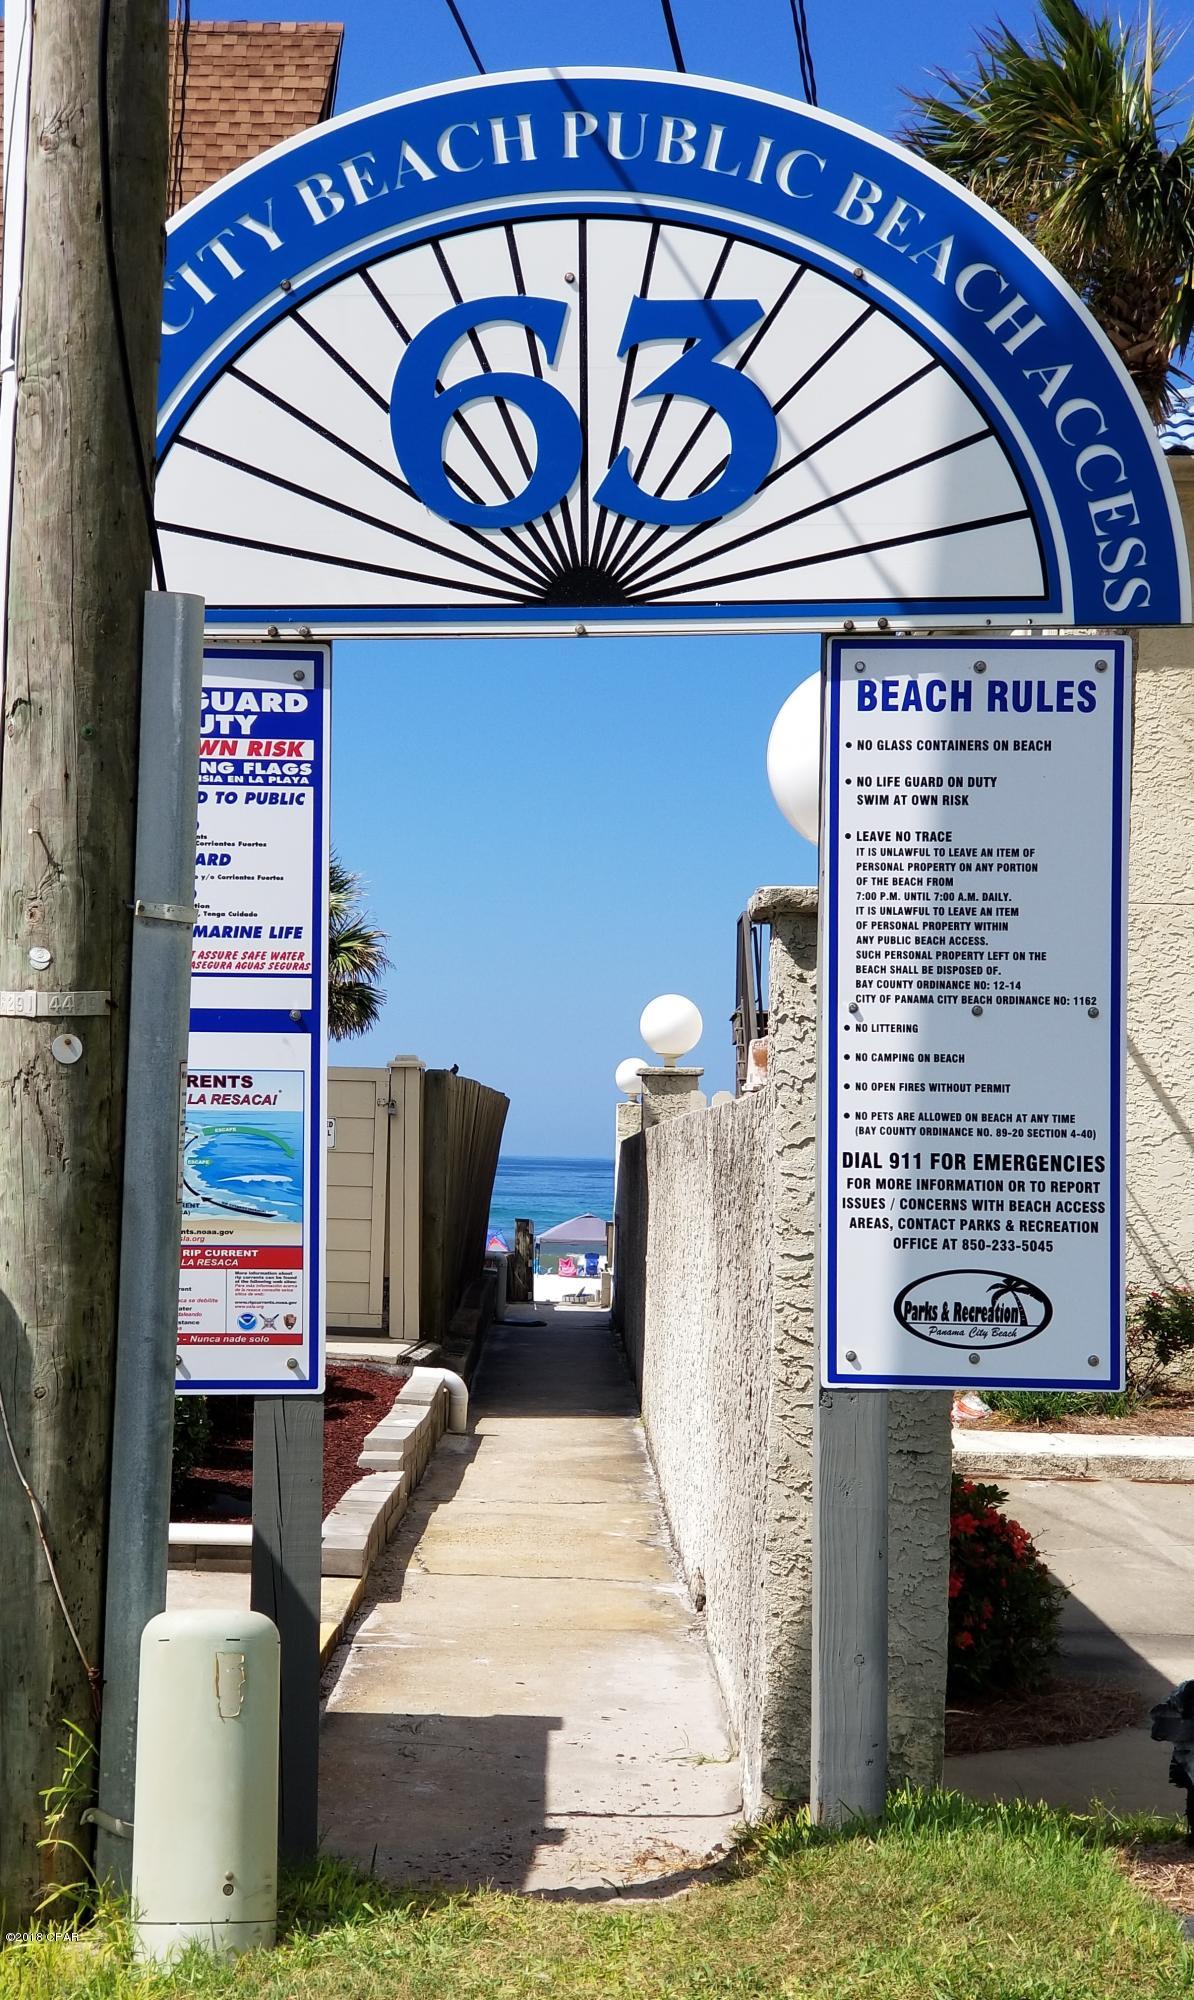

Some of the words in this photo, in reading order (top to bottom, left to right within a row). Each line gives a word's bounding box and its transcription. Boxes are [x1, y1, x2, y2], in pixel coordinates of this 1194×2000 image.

[294, 113, 538, 226] BEACH
[562, 110, 827, 199] PUBLIC
[832, 171, 1048, 357] BEACH
[1021, 362, 1151, 613] ACCESS
[390, 295, 778, 527] 63
[858, 679, 972, 712] BEACH
[988, 680, 1096, 713] RULES
[246, 740, 305, 758] RISK
[856, 739, 873, 751] NO
[876, 739, 913, 751] GLASS
[916, 739, 990, 752] CONTAINERS
[992, 739, 1009, 752] ON
[1013, 739, 1052, 752] BEACH
[243, 762, 312, 775] FLAGS
[227, 775, 244, 784] EN
[248, 775, 264, 784] LA
[268, 775, 310, 785] PLAYA
[856, 775, 873, 788] NO
[876, 776, 901, 788] LIFE
[904, 776, 944, 788] GUARD
[947, 776, 964, 788] ON
[967, 776, 998, 788] DUTY
[215, 791, 238, 805] TO
[244, 791, 306, 806] PUBLIC
[856, 794, 890, 806] SWIM
[893, 794, 908, 806] AT
[911, 794, 938, 806] OWN
[942, 794, 969, 807] RISK
[856, 830, 892, 842] LEAVE
[895, 830, 912, 842] NO
[914, 830, 953, 843] TRACE
[217, 873, 255, 881] Corrientes
[257, 874, 284, 882] Fuertes
[855, 891, 877, 901] 7:00
[879, 891, 901, 901] P.M.
[903, 891, 932, 902] UNTIL
[933, 891, 955, 902] 7:00
[957, 891, 980, 902] A.M.
[981, 892, 1012, 902] DAILY.
[203, 910, 226, 919] Tenga
[228, 910, 258, 918] Cuidado
[193, 924, 263, 939] MARINE
[268, 925, 304, 940] LIFE
[855, 935, 875, 945] ANY
[877, 935, 912, 946] PUBLIC
[914, 935, 946, 946] BEACH
[948, 935, 989, 946] ACCESS.
[197, 950, 239, 960] ASSURE
[240, 950, 268, 961] SAFE
[270, 951, 306, 962] WATER
[855, 949, 882, 960] SUCH
[884, 950, 934, 960] PERSONAL
[935, 950, 985, 961] PROPERTY
[987, 951, 1010, 961] LEFT
[1012, 951, 1026, 961] ON
[1028, 951, 1047, 961] THE
[191, 960, 233, 970] ASEGURA
[235, 961, 266, 971] AGUAS
[267, 961, 311, 972] SEGURAS
[855, 964, 887, 975] BEACH
[889, 964, 919, 975] SHALL
[921, 965, 934, 975] BE
[936, 965, 984, 976] DISPOSED
[985, 965, 1002, 976] OF.
[855, 979, 874, 989] BAY
[876, 979, 914, 990] COUNTY
[916, 979, 971, 990] ORDINANCE
[973, 980, 990, 991] NO:
[992, 980, 1022, 991] 12-14
[855, 993, 877, 1004] CITY
[879, 994, 892, 1004] OF
[894, 994, 935, 1005] PANAMA
[936, 994, 959, 1005] CITY
[960, 995, 993, 1006] BEACH
[995, 995, 1051, 1006] ORDINANCE
[1053, 995, 1070, 1006] NO:
[1073, 996, 1097, 1006] 1162
[855, 1023, 868, 1033] NO
[871, 1023, 919, 1034] LITTERING
[855, 1052, 868, 1062] NO
[870, 1052, 915, 1063] CAMPING
[917, 1053, 931, 1063] ON
[933, 1053, 965, 1064] BEACH
[855, 1081, 868, 1092] NO
[870, 1081, 896, 1092] OPEN
[898, 1082, 926, 1093] FIRES
[928, 1082, 972, 1093] WITHOUT
[974, 1083, 1011, 1094] PERMIT
[187, 1093, 207, 1105] LA
[854, 1111, 868, 1121] NO
[870, 1111, 894, 1121] PETS
[896, 1111, 916, 1122] ARE
[917, 1111, 962, 1122] ALLOWED
[964, 1112, 978, 1123] ON
[980, 1112, 1013, 1123] BEACH
[1015, 1113, 1028, 1124] AT
[1030, 1113, 1050, 1124] ANY
[1051, 1113, 1076, 1124] TIME
[854, 1125, 877, 1137] (BAY
[879, 1126, 917, 1136] COUNTY
[919, 1126, 974, 1137] ORDINANCE
[976, 1127, 993, 1138] NO.
[995, 1127, 1025, 1138] 89-20
[1026, 1128, 1068, 1139] SECTION
[1069, 1129, 1097, 1141] 4-40)
[843, 1152, 882, 1168] DIAL
[890, 1153, 920, 1169] 911
[931, 1153, 966, 1170] FOR
[974, 1154, 1105, 1172] EMERGENCIES
[846, 1177, 872, 1190] FOR
[875, 1177, 912, 1191] MORE
[916, 1178, 1004, 1192] INFORMATION
[1008, 1179, 1026, 1193] OR
[1029, 1180, 1046, 1193] TO
[1050, 1180, 1101, 1194] REPORT
[842, 1196, 886, 1210] ISSUES
[899, 1197, 968, 1212] CONCERNS
[971, 1199, 1005, 1212] WITH
[1008, 1199, 1052, 1213] BEACH
[1055, 1200, 1106, 1214] ACCESS
[848, 1216, 894, 1232] AREAS,
[897, 1217, 956, 1231] CONTACT
[959, 1218, 1001, 1232] PARKS
[1005, 1219, 1015, 1232] &
[1019, 1219, 1099, 1234] RECREATION
[893, 1236, 938, 1250] OFFICE
[941, 1237, 959, 1251] AT
[961, 1238, 1054, 1253] 850-233-5045
[182, 1249, 202, 1257] RIP
[204, 1249, 260, 1257] CURRENT
[180, 1258, 195, 1267] LA
[195, 1258, 239, 1267] RESACA
[903, 1300, 938, 1322] Parks
[940, 1300, 950, 1322] &
[952, 1301, 1019, 1324] Recreation
[190, 1335, 221, 1343] Nunca
[222, 1335, 247, 1343] nade
[248, 1335, 270, 1343] solo
[928, 1325, 965, 1337] Panama
[968, 1326, 989, 1340] City
[990, 1327, 1018, 1338] Beach
